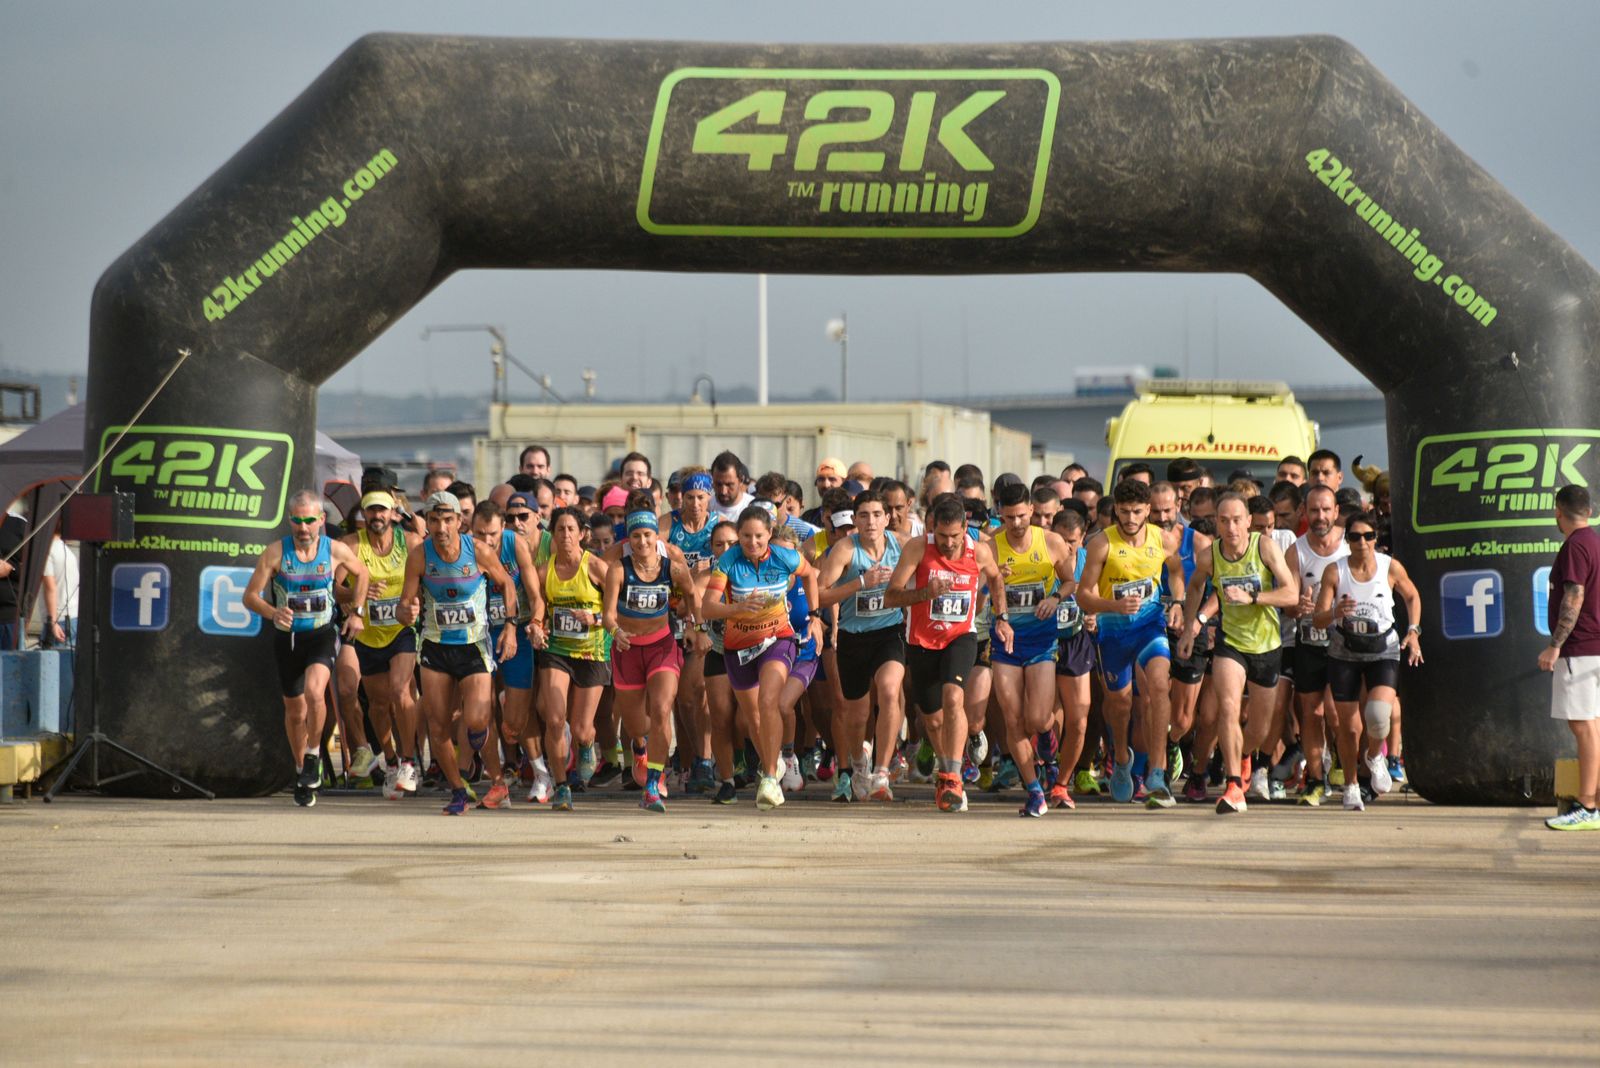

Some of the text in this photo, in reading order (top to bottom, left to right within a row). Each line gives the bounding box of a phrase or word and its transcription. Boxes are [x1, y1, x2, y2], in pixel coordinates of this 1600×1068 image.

[692, 90, 1007, 172] 42K
[787, 172, 989, 222] TM running
[202, 148, 399, 322] 42krunning.com
[1304, 147, 1498, 328] 42krunning.com
[110, 440, 273, 491] 42K
[1431, 443, 1592, 492] 42K
[169, 488, 262, 517] running
[1498, 486, 1560, 512] runni
[303, 598, 311, 612] 1
[637, 593, 658, 609] 56
[942, 598, 962, 615] 84
[442, 609, 469, 625] 124
[559, 615, 583, 632] 154
[1351, 620, 1367, 633] 10
